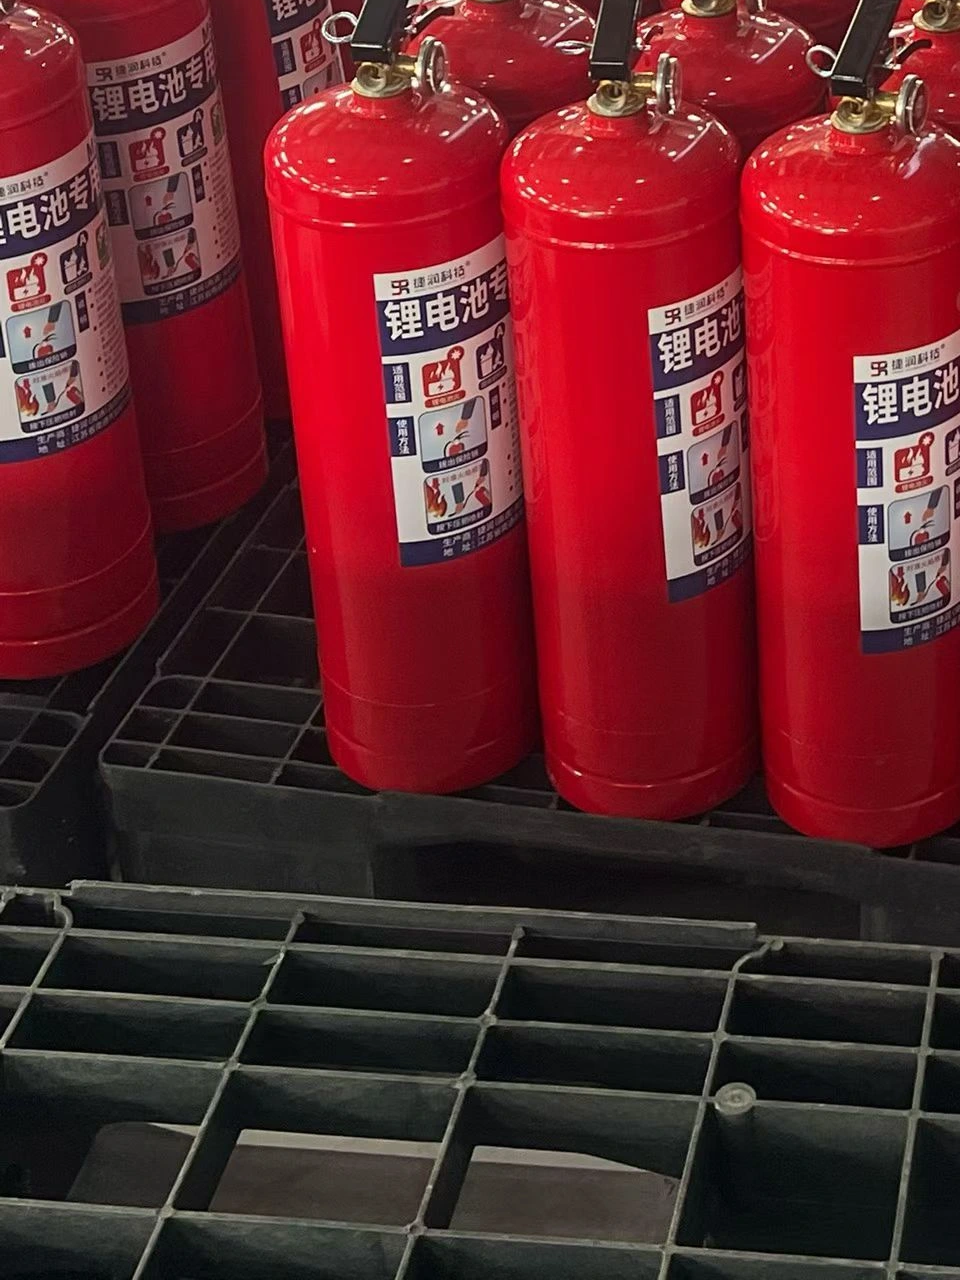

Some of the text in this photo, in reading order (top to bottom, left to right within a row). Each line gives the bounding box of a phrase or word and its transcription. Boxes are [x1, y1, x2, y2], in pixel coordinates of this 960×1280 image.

[92, 42, 216, 121] 锂电池专用
[384, 265, 508, 341] 锂电池专
[658, 299, 741, 375] 锂电池
[396, 419, 410, 455] 使用方法
[867, 507, 879, 542] 使用方法
